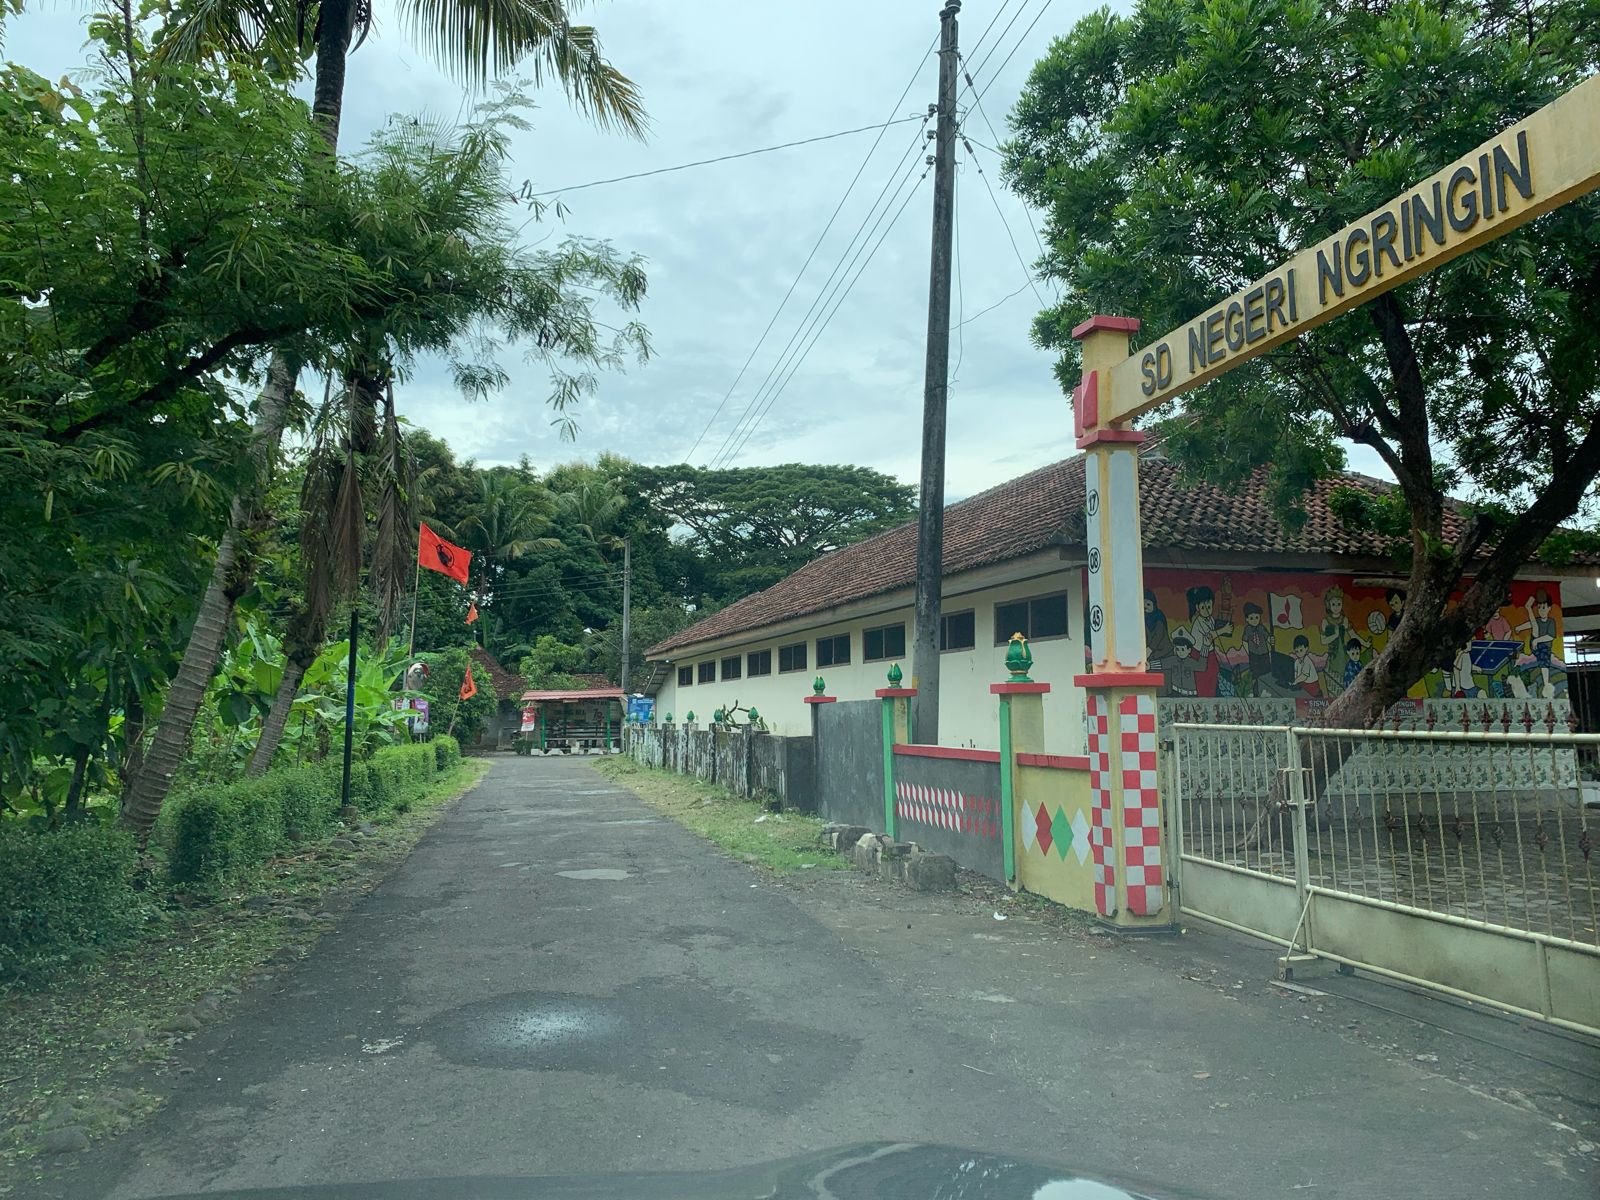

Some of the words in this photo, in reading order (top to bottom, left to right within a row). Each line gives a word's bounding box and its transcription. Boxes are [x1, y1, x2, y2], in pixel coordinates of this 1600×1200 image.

[1141, 345, 1172, 396] SD
[1187, 268, 1299, 374] NEGERI
[1316, 130, 1535, 305] NGRINGIN
[1088, 493, 1097, 512] 17
[1090, 551, 1099, 569] 08
[1092, 610, 1101, 627] 45
